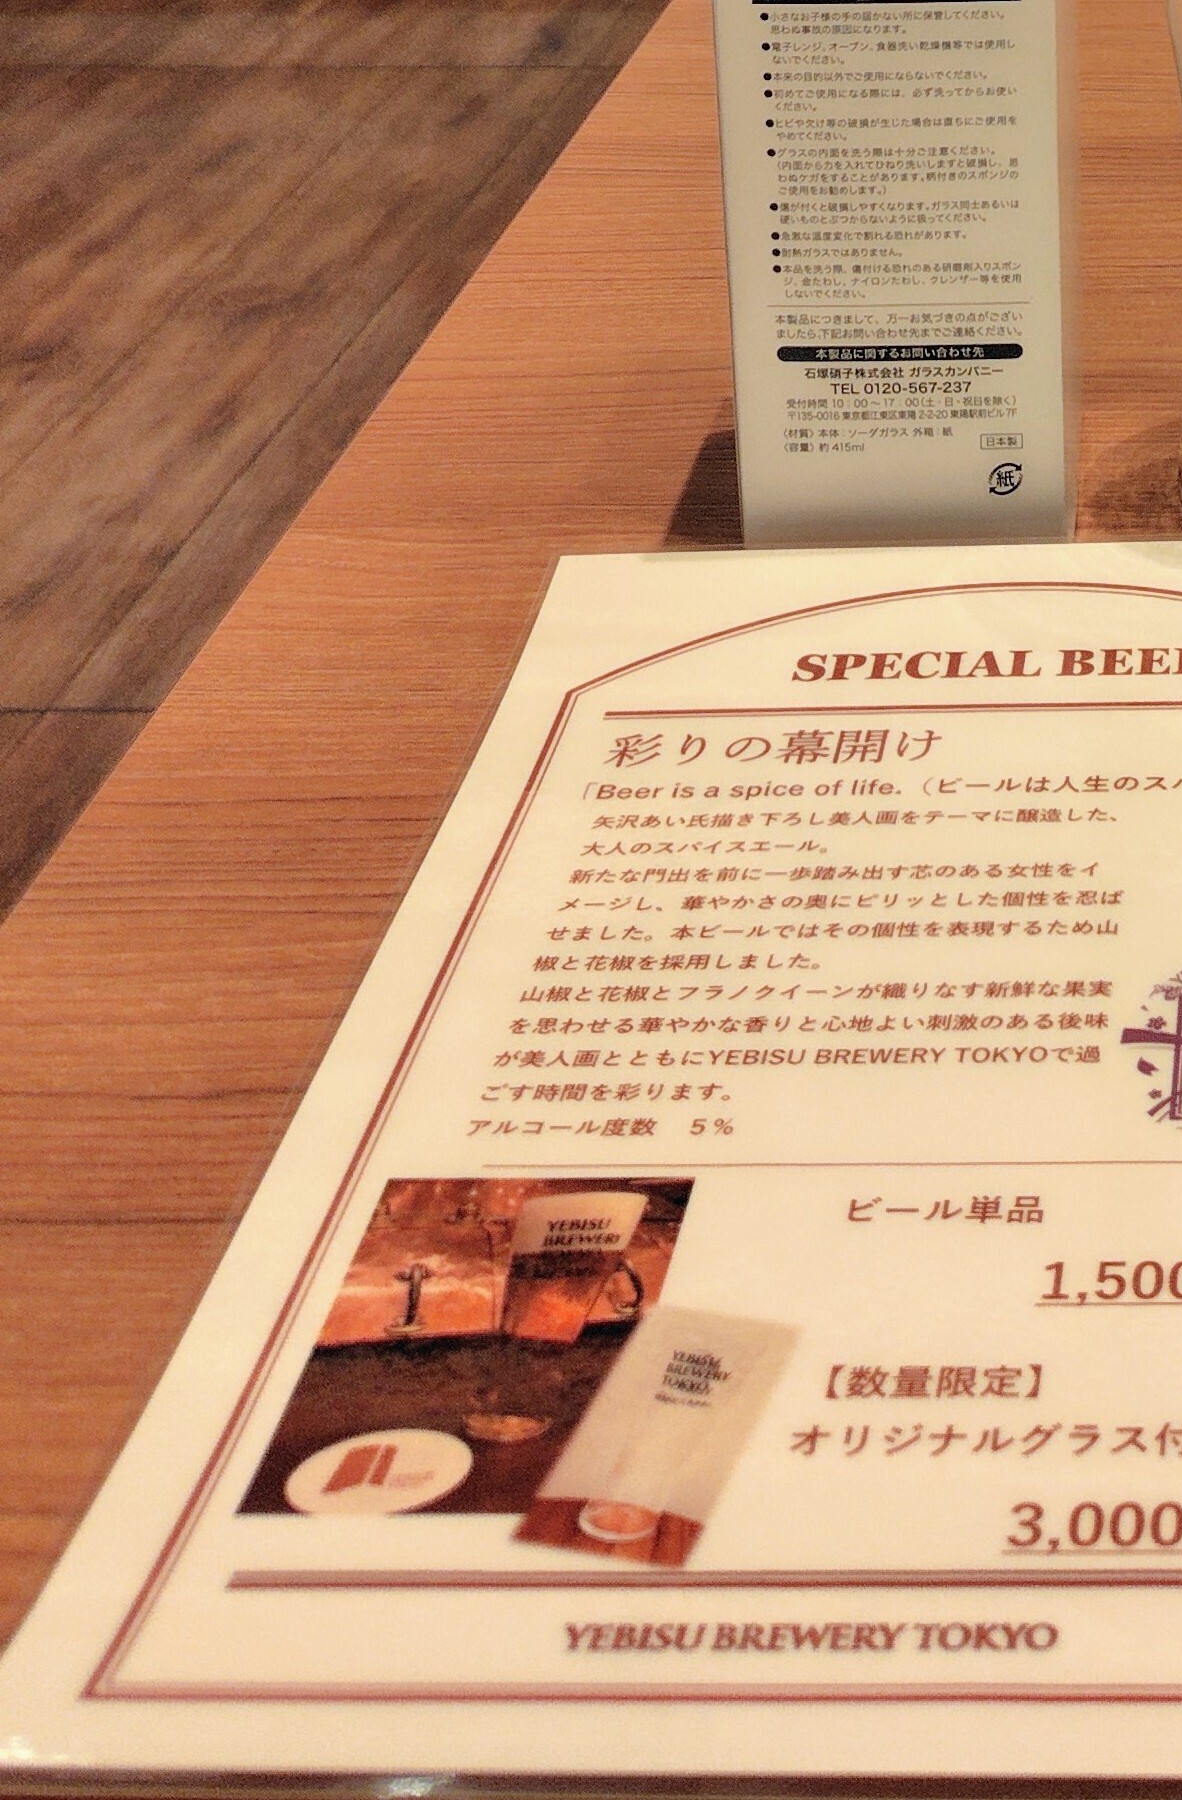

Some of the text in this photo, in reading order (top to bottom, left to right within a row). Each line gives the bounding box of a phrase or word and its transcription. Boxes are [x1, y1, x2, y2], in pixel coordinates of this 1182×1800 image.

[775, 101, 818, 112] ください。
[815, 347, 985, 361] 本製品に関するお問い合わせ先
[830, 381, 972, 395] TEL 0120-567-237
[985, 436, 1018, 448] 日本製
[791, 648, 1042, 682] SPECIAL
[603, 728, 943, 769] 彩りの幕開け
[673, 781, 695, 799] is
[703, 786, 719, 799] a
[731, 780, 805, 801] spice
[815, 779, 843, 797] of
[851, 778, 902, 797] life.
[591, 806, 1119, 831] 矢沢あい氏描き下ろし美人画をテーマに醸造した、
[580, 839, 828, 857] 大人のスパイスエール。
[568, 861, 1099, 885] 新たな門出を前に一歩踏み出す芯のある女性をイ
[557, 889, 1125, 913] メージし、華やかさの奥にピリッとした個性を忍ば
[546, 919, 1119, 942] せました。本ビールではその個性を表現するため山
[532, 953, 821, 973] 椒と花椒を採用しました。
[508, 1011, 1110, 1035] を思わせる華やかな香りと心地よい刺激のある後味
[813, 1047, 947, 1066] BREWERY
[480, 1082, 731, 1102] ごす時間を彩ります。
[466, 1117, 658, 1137] アルコール度数
[847, 1195, 1045, 1224] ビール単品
[824, 1363, 1044, 1400] 【数量限定】
[564, 1622, 1060, 1652] YEBISU BREWERY TOKYO
